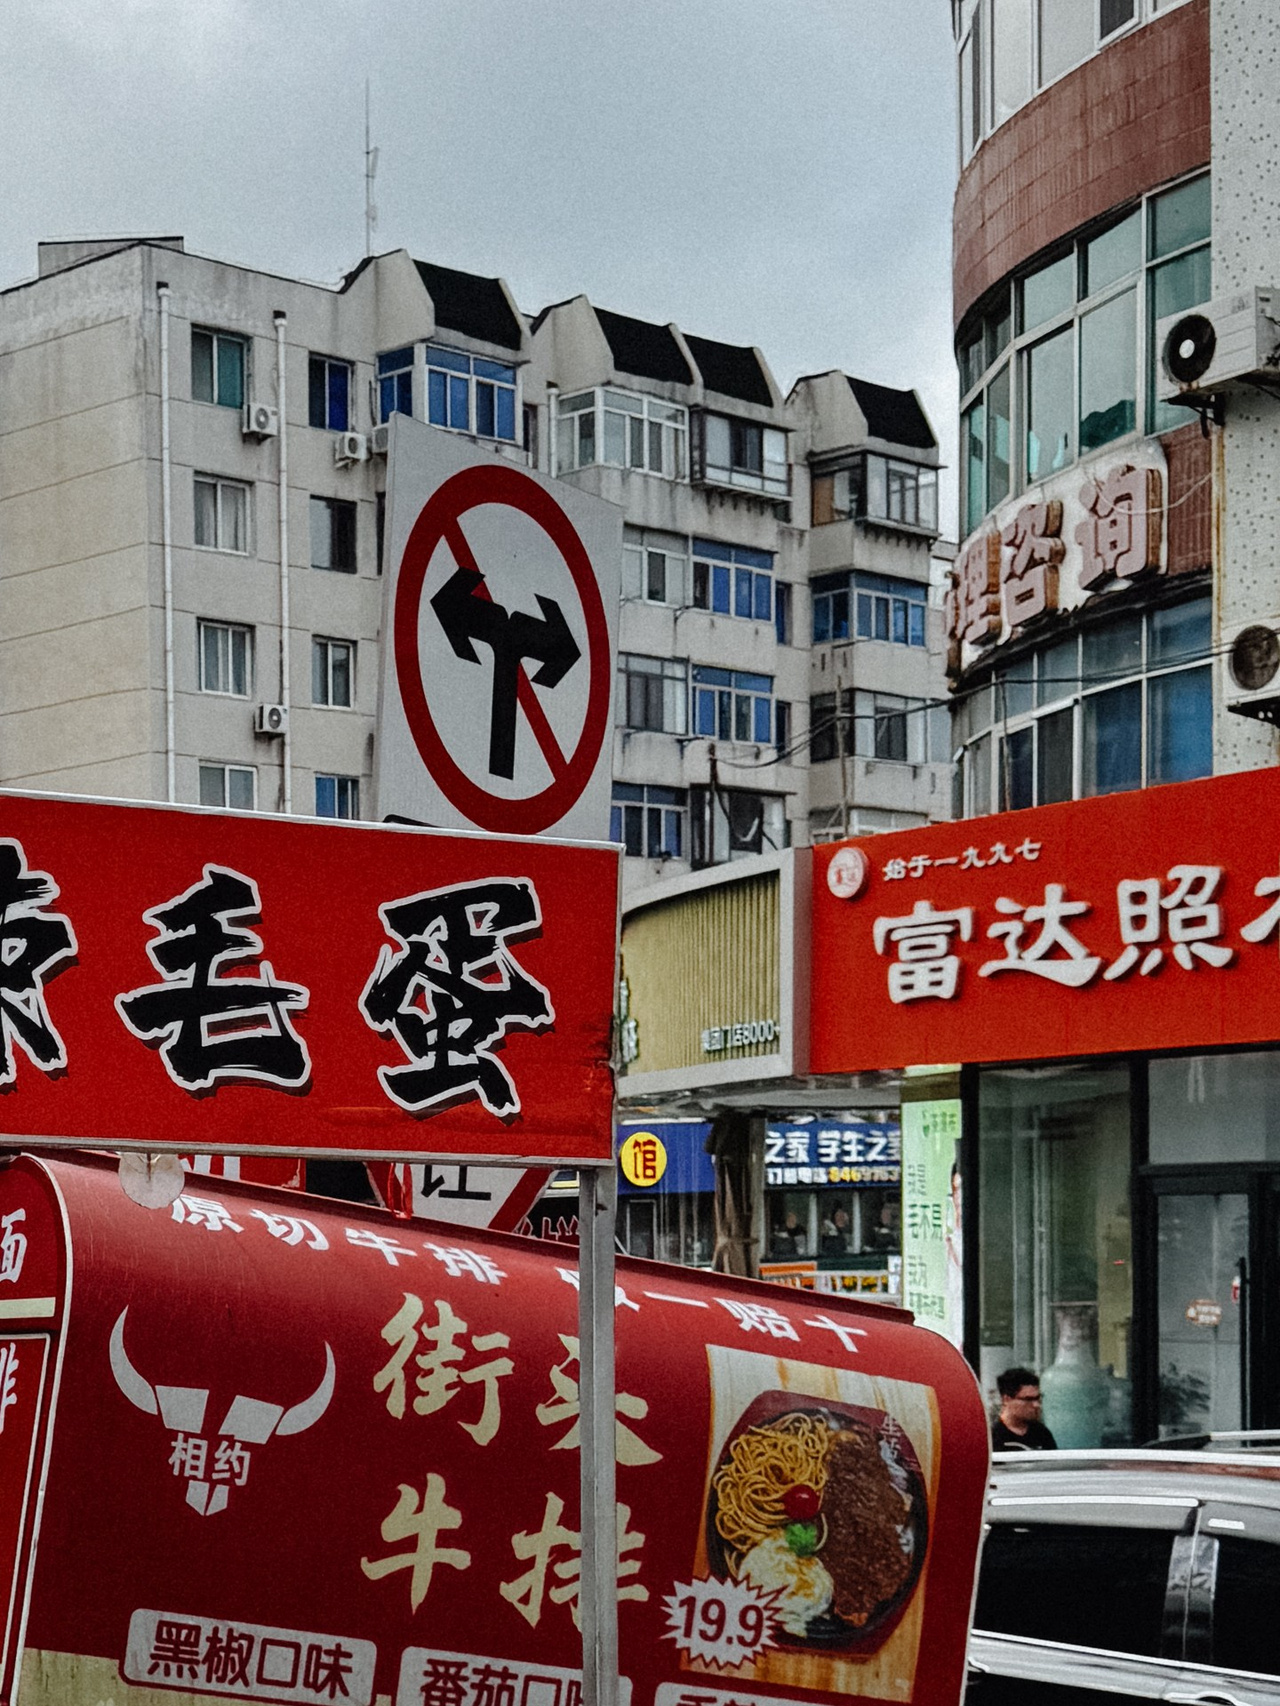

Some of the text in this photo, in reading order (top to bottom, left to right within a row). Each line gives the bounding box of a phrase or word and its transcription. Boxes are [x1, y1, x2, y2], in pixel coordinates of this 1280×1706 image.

[946, 465, 1152, 645] 理咨询
[882, 838, 1042, 880] 始于一九九七
[632, 1138, 658, 1180] 馆
[171, 1195, 508, 1285] 原切牛排
[168, 1434, 251, 1487] 相约
[361, 1473, 650, 1634] 牛排
[679, 1597, 764, 1651] 19.9
[148, 1618, 353, 1699] 黑椒口味
